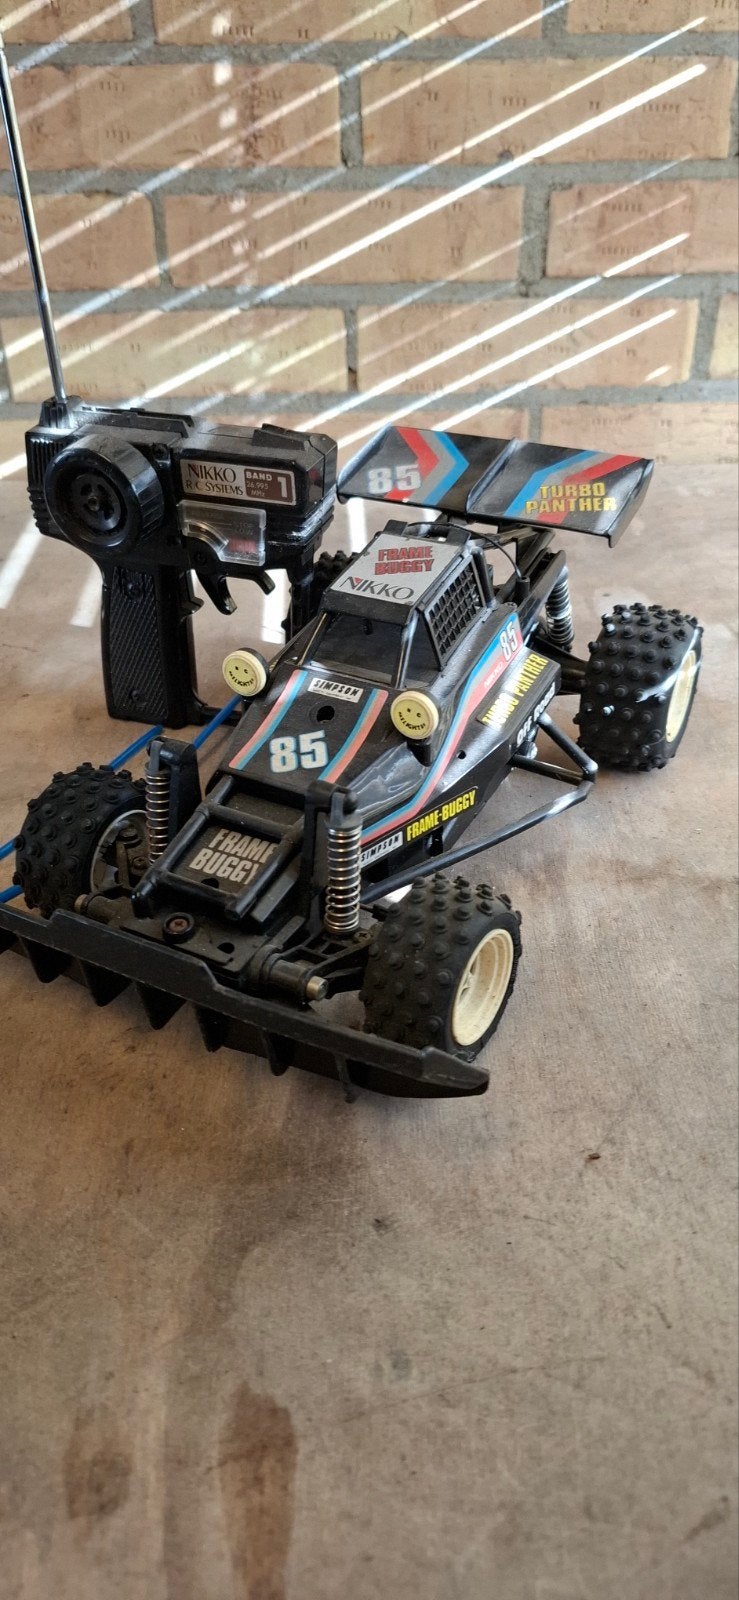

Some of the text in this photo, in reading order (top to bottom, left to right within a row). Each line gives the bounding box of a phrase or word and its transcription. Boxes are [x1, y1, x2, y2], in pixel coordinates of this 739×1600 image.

[187, 463, 236, 483] NIKKO
[246, 471, 273, 481] BAND
[367, 464, 423, 494] 85
[205, 481, 243, 496] SYSTEMS
[277, 476, 288, 498] 1
[540, 482, 606, 499] TURBO
[525, 497, 618, 514] PANTHER
[378, 546, 433, 561] FRAME
[374, 559, 435, 575] BUGGY
[339, 576, 415, 600] NIKKO
[499, 621, 519, 662] 85
[313, 680, 360, 696] SIMPSON
[268, 729, 330, 773] 85
[406, 789, 476, 842] FRAME-BUGGY
[361, 834, 400, 862] SIMPSON
